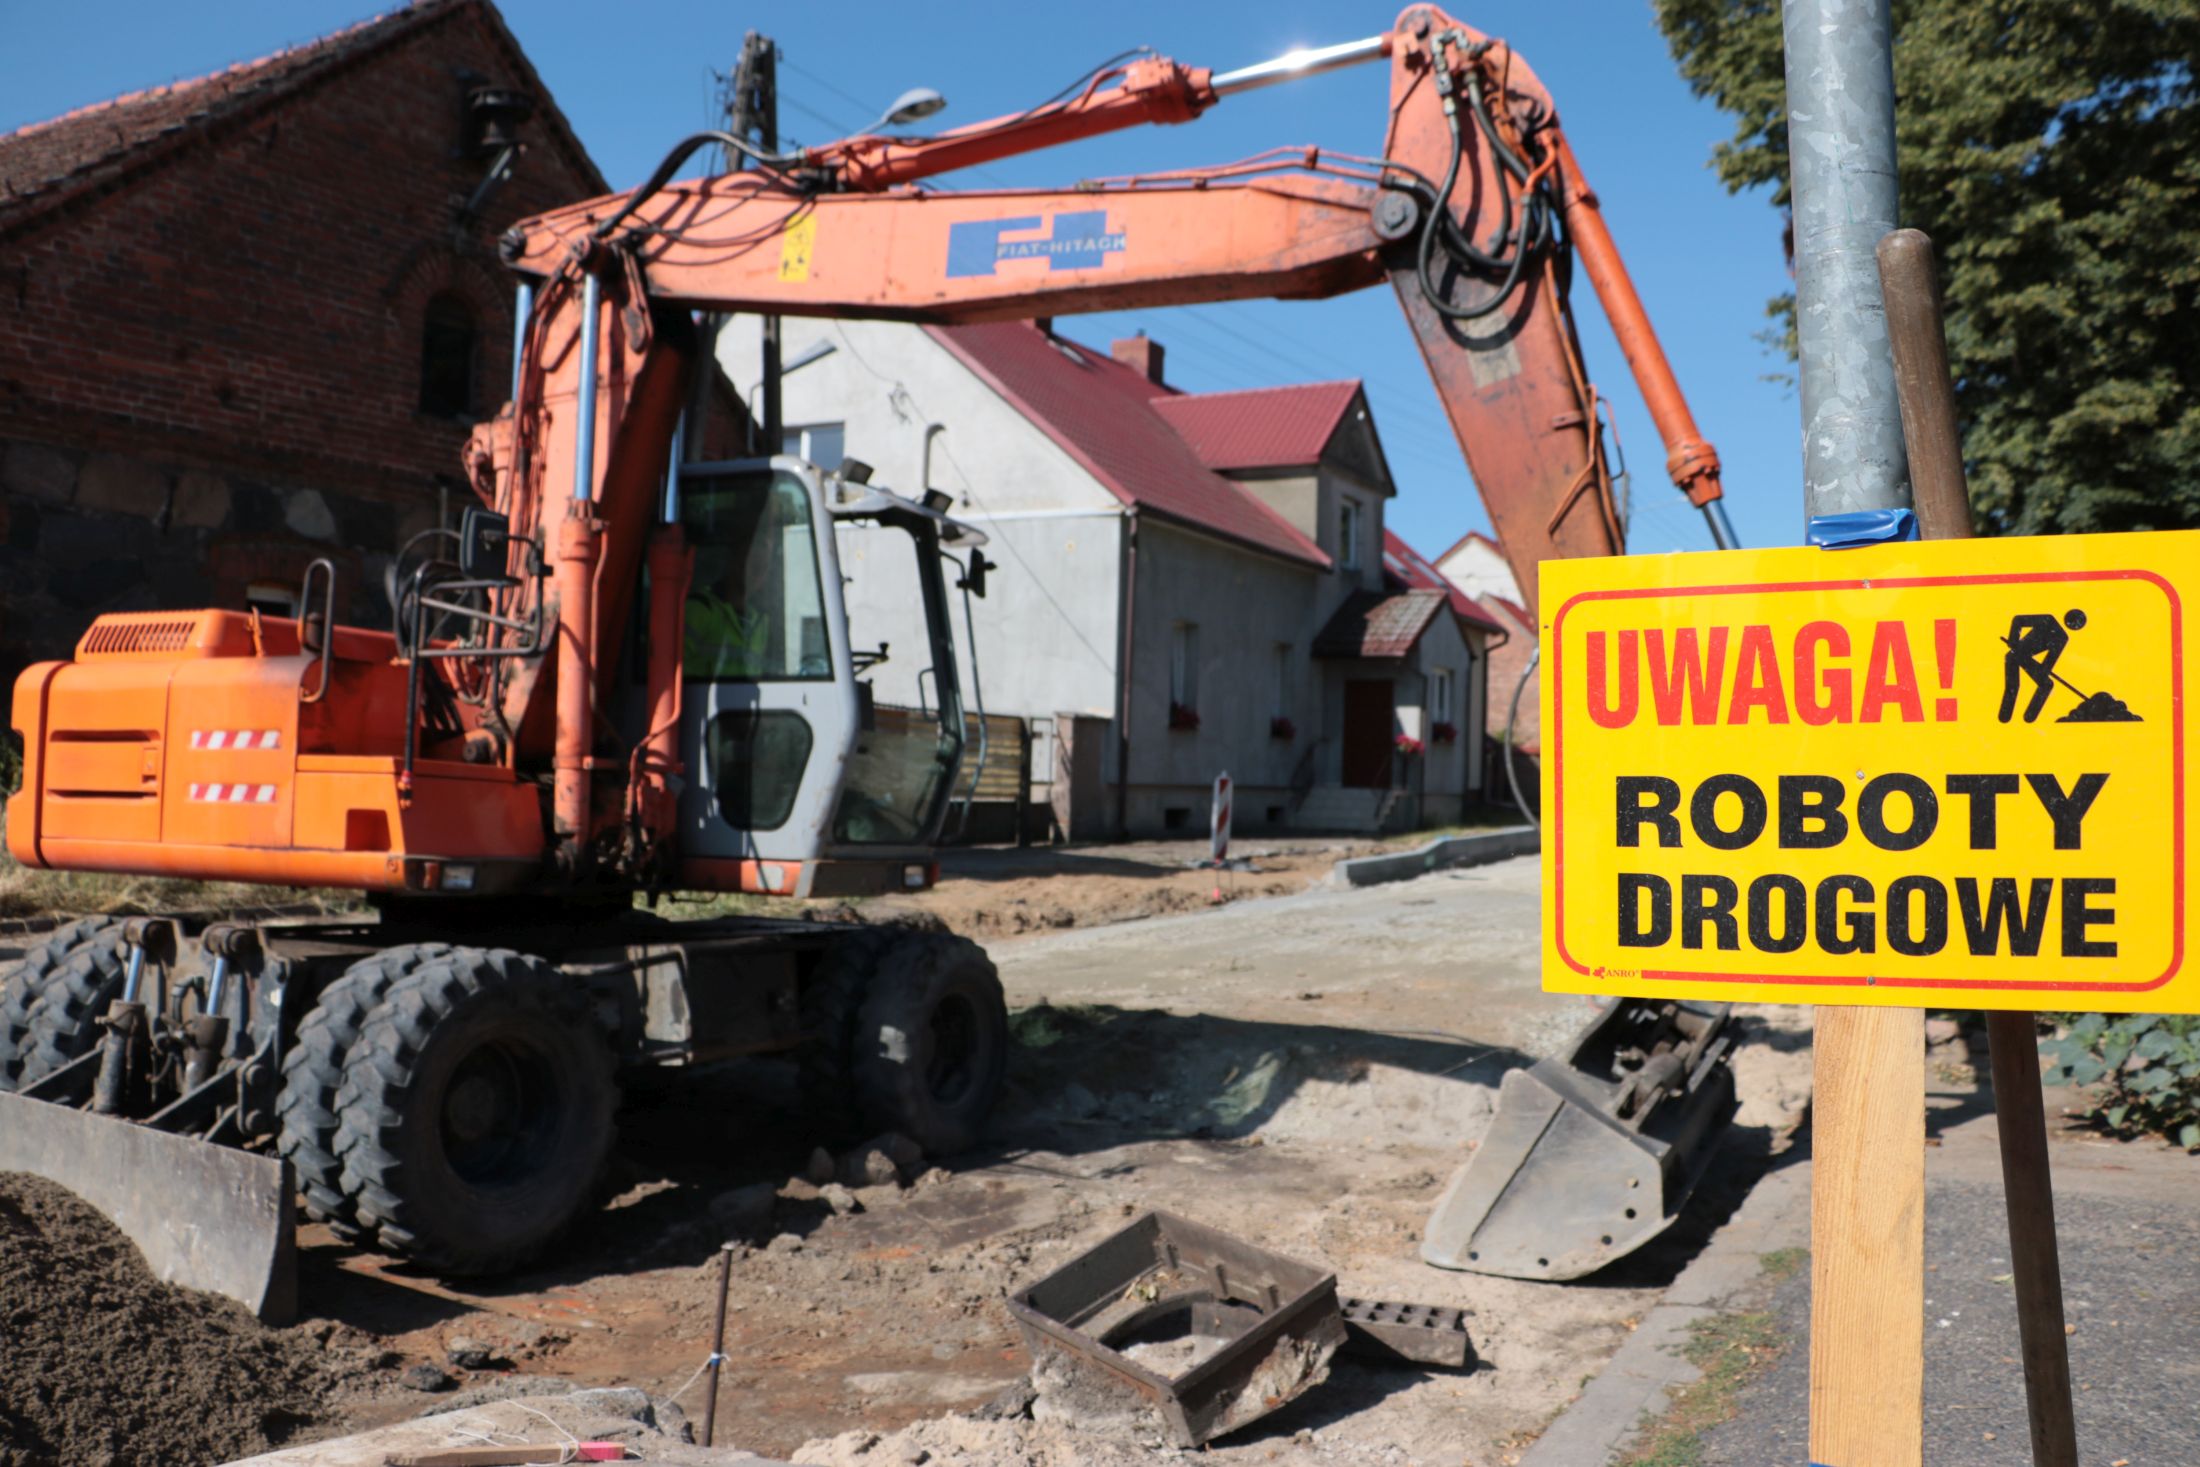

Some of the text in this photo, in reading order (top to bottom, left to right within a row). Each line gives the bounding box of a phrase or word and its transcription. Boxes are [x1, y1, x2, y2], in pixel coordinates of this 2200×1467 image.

[1585, 618, 1959, 729] UWAGA!
[1615, 772, 2111, 852] ROBOTY
[1617, 873, 2119, 959] DROGOWE
